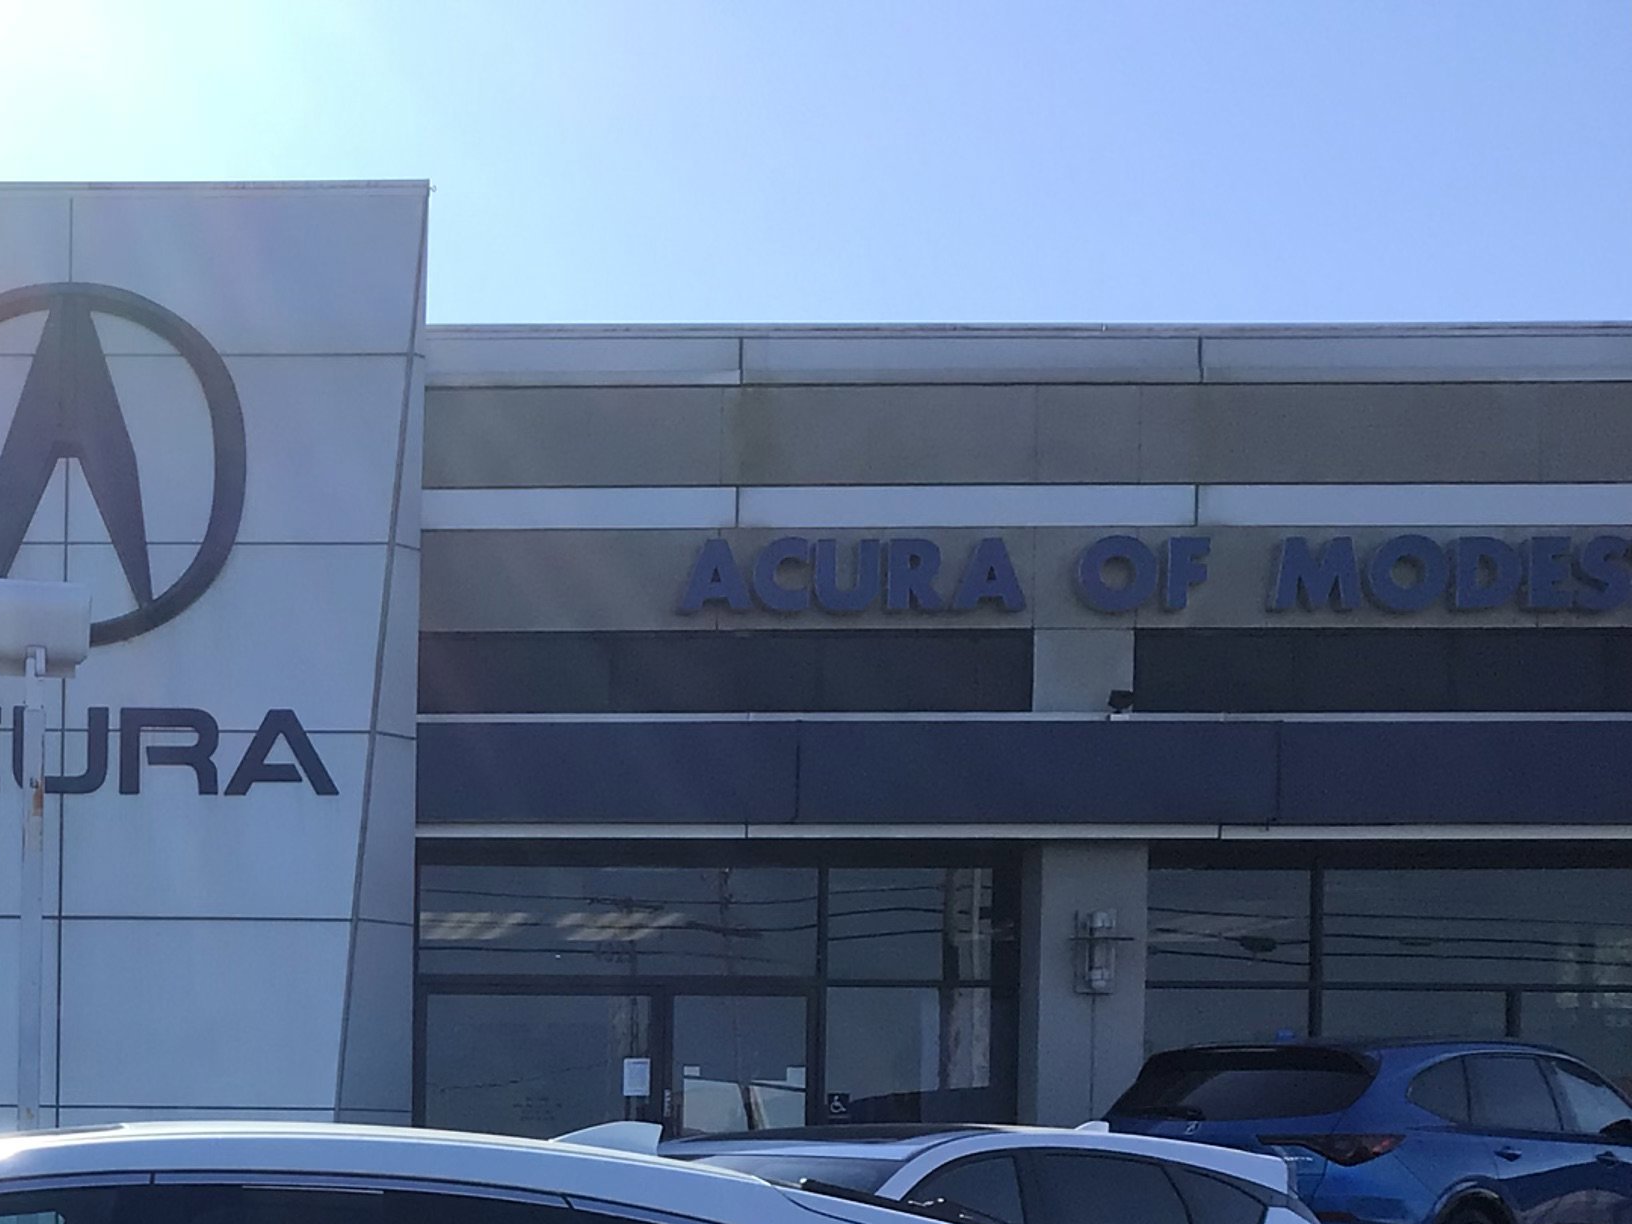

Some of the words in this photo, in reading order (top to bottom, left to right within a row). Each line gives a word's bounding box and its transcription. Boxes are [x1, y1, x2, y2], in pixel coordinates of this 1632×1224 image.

[678, 535, 1027, 613] ACURA
[1075, 534, 1212, 613] OF
[1273, 533, 1632, 611] MODES
